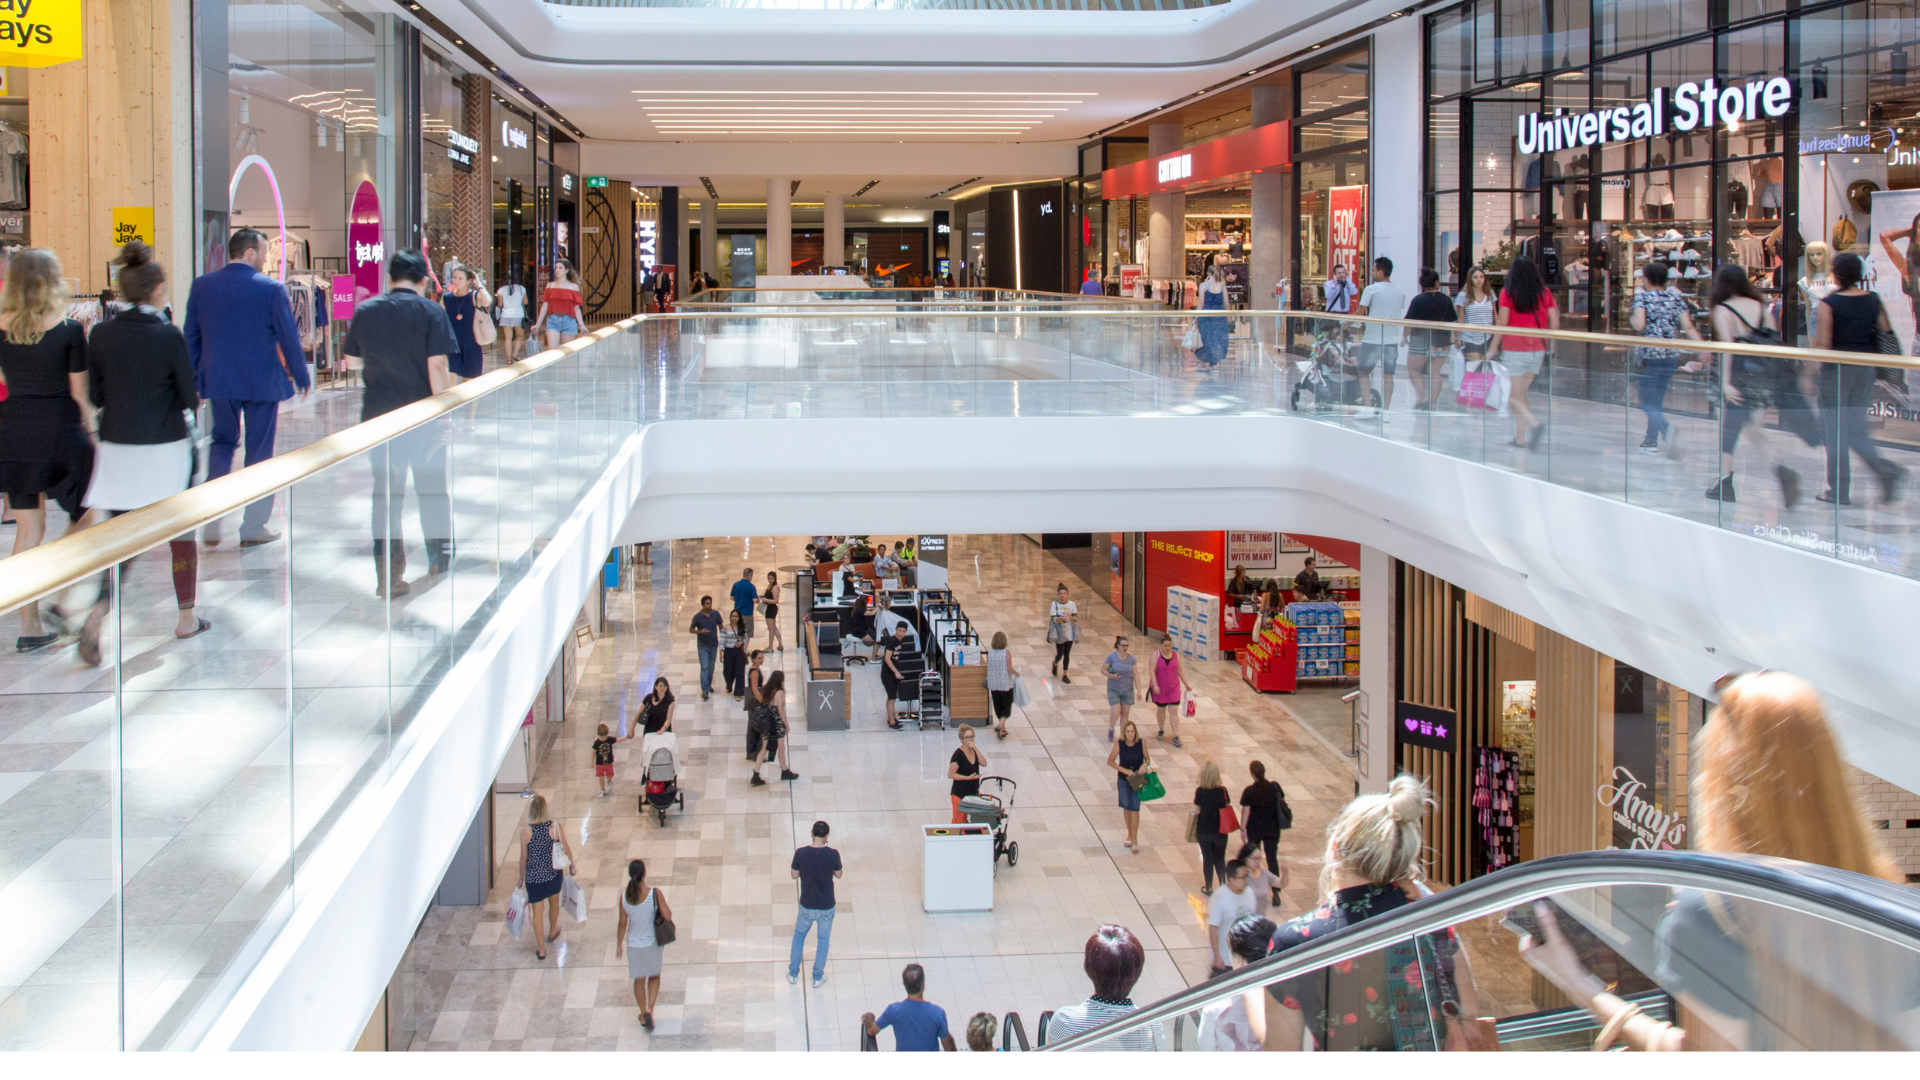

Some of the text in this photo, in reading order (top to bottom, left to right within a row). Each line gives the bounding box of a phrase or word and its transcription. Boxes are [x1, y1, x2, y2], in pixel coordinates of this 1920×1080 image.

[0, 0, 32, 18] ay
[0, 20, 53, 48] ays
[1518, 76, 1792, 155] Universal Store
[0, 216, 23, 227] ver
[115, 222, 136, 234] Jay
[1333, 208, 1357, 246] 50%
[1333, 247, 1357, 279] OFF
[333, 294, 353, 302] SALE
[1231, 533, 1273, 543] ONE THING
[1151, 539, 1214, 563] THE REJECT SHOP
[1231, 553, 1273, 561] WITH MANY
[1597, 766, 1686, 850] Amy's
[1613, 811, 1632, 829] CARDS
[1637, 826, 1655, 844] GIFTS
